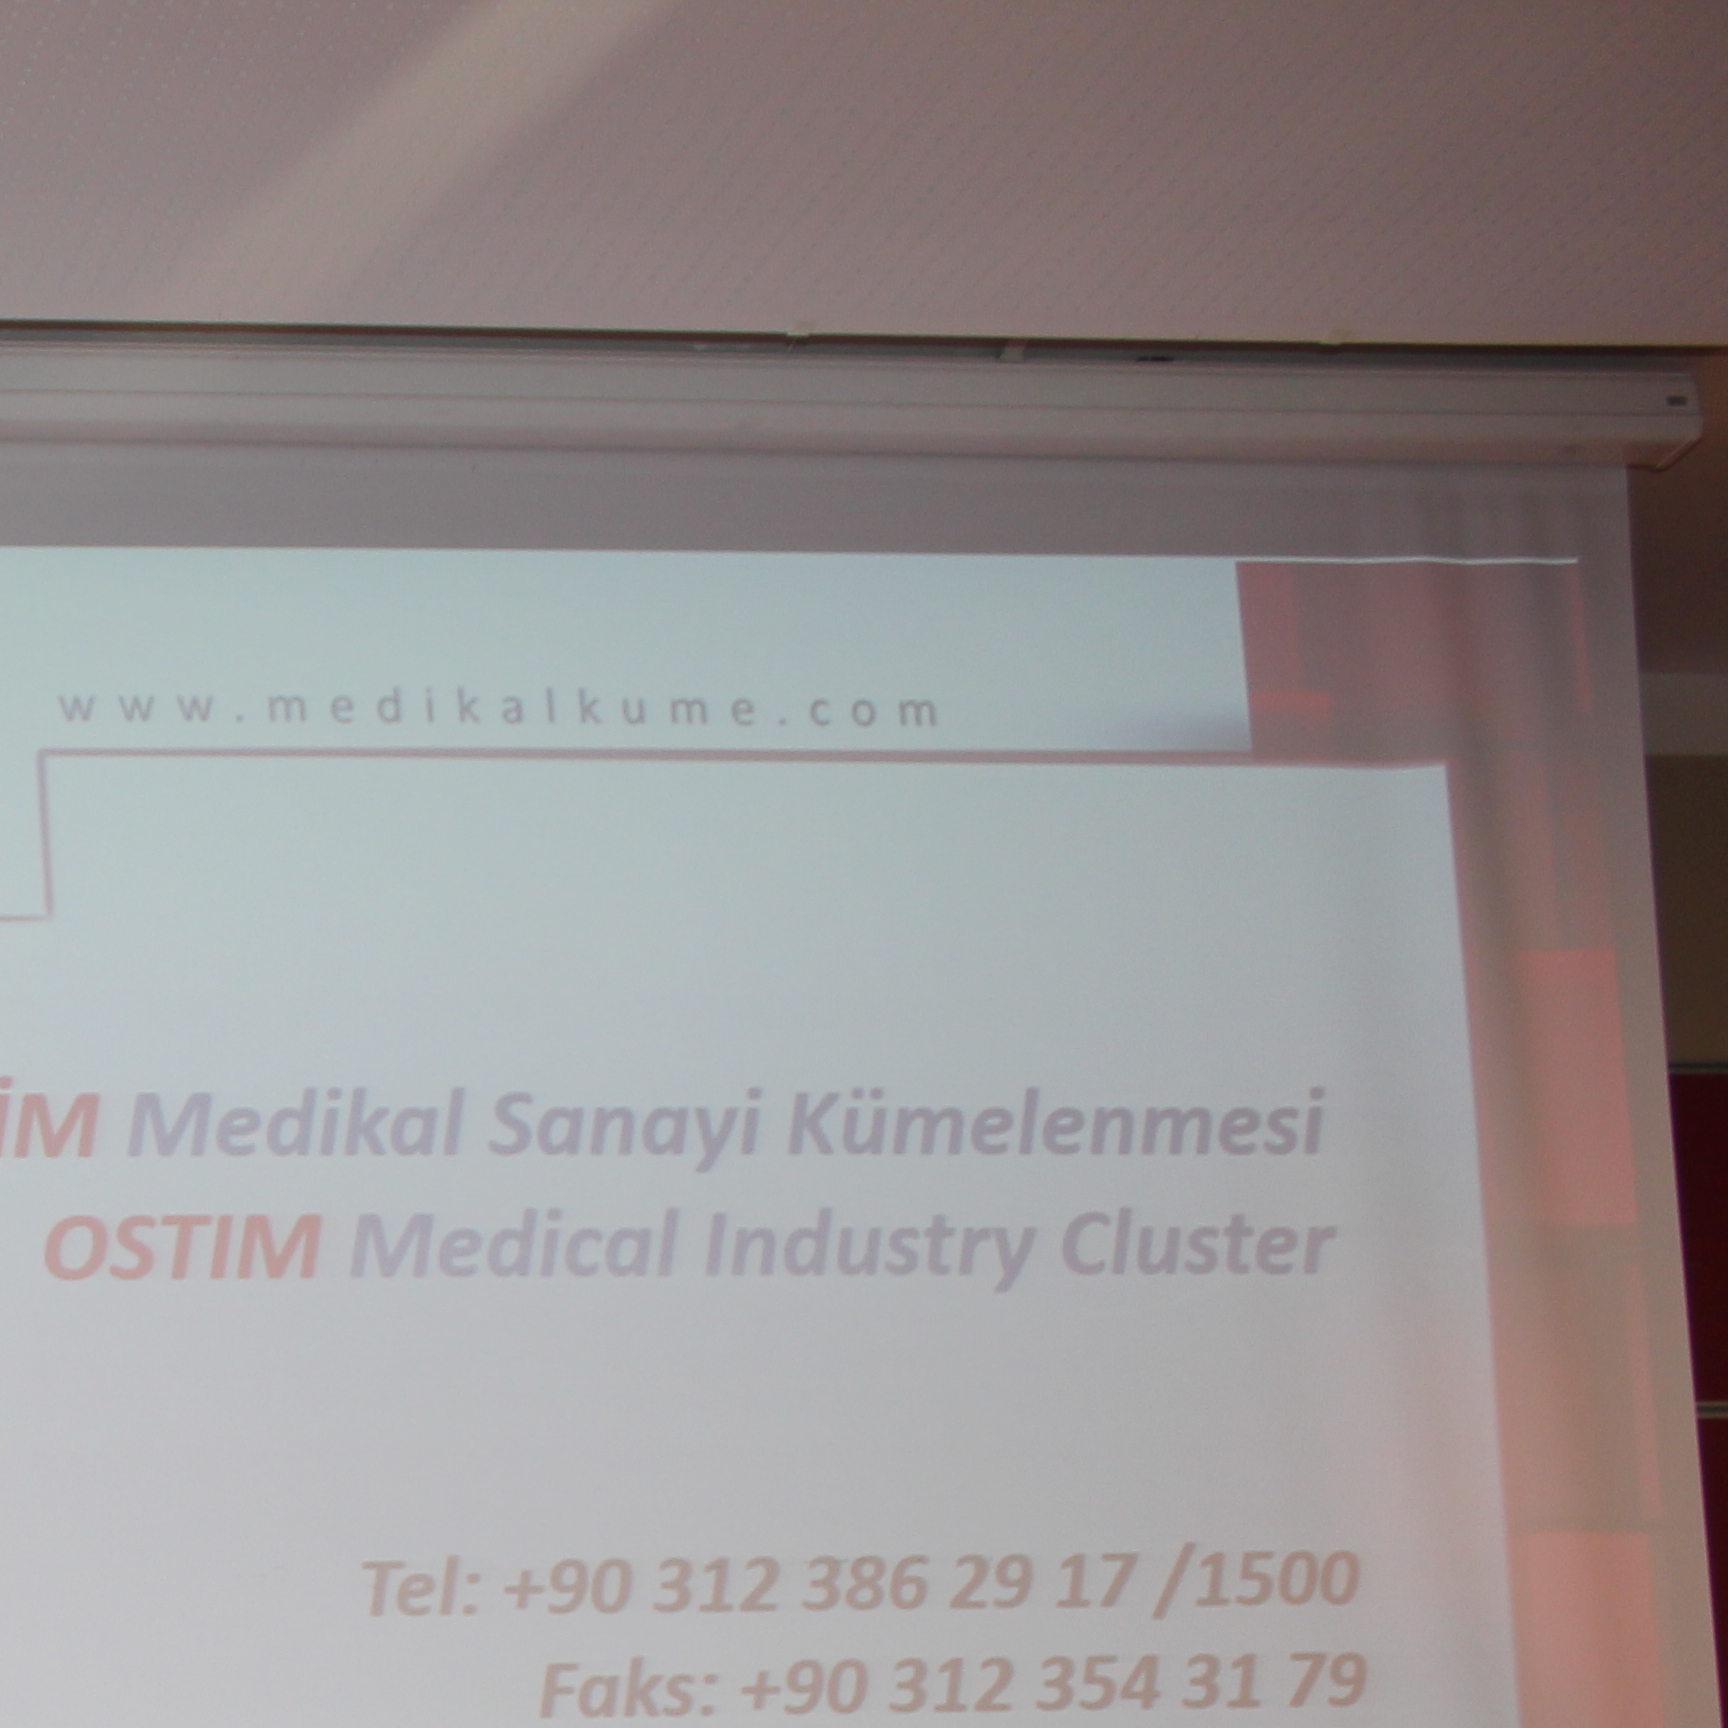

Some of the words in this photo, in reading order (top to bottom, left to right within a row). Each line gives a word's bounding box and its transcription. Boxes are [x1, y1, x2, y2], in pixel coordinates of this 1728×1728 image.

[57, 687, 939, 727] www.medikalkume.com
[126, 1086, 462, 1161] Medikal
[487, 1088, 764, 1174] Sanayi
[784, 1086, 1328, 1160] Kümelenmesi
[42, 1212, 324, 1281] OSTIM
[349, 1210, 677, 1281] Medical
[704, 1210, 1036, 1295] Industry
[1060, 1208, 1340, 1277] Cluster
[361, 1556, 481, 1618] Tel:
[502, 1557, 634, 1617] +90
[653, 1557, 781, 1615] 312
[801, 1556, 931, 1613] 386
[949, 1554, 1034, 1611] 29
[1054, 1552, 1138, 1609] 17
[1152, 1542, 1362, 1620] /1500
[540, 1657, 720, 1720] Faks:
[740, 1658, 869, 1717] +90
[888, 1657, 1016, 1715] 312
[1035, 1655, 1162, 1713] 354
[1182, 1654, 1263, 1711] 31
[1287, 1652, 1370, 1709] 79
